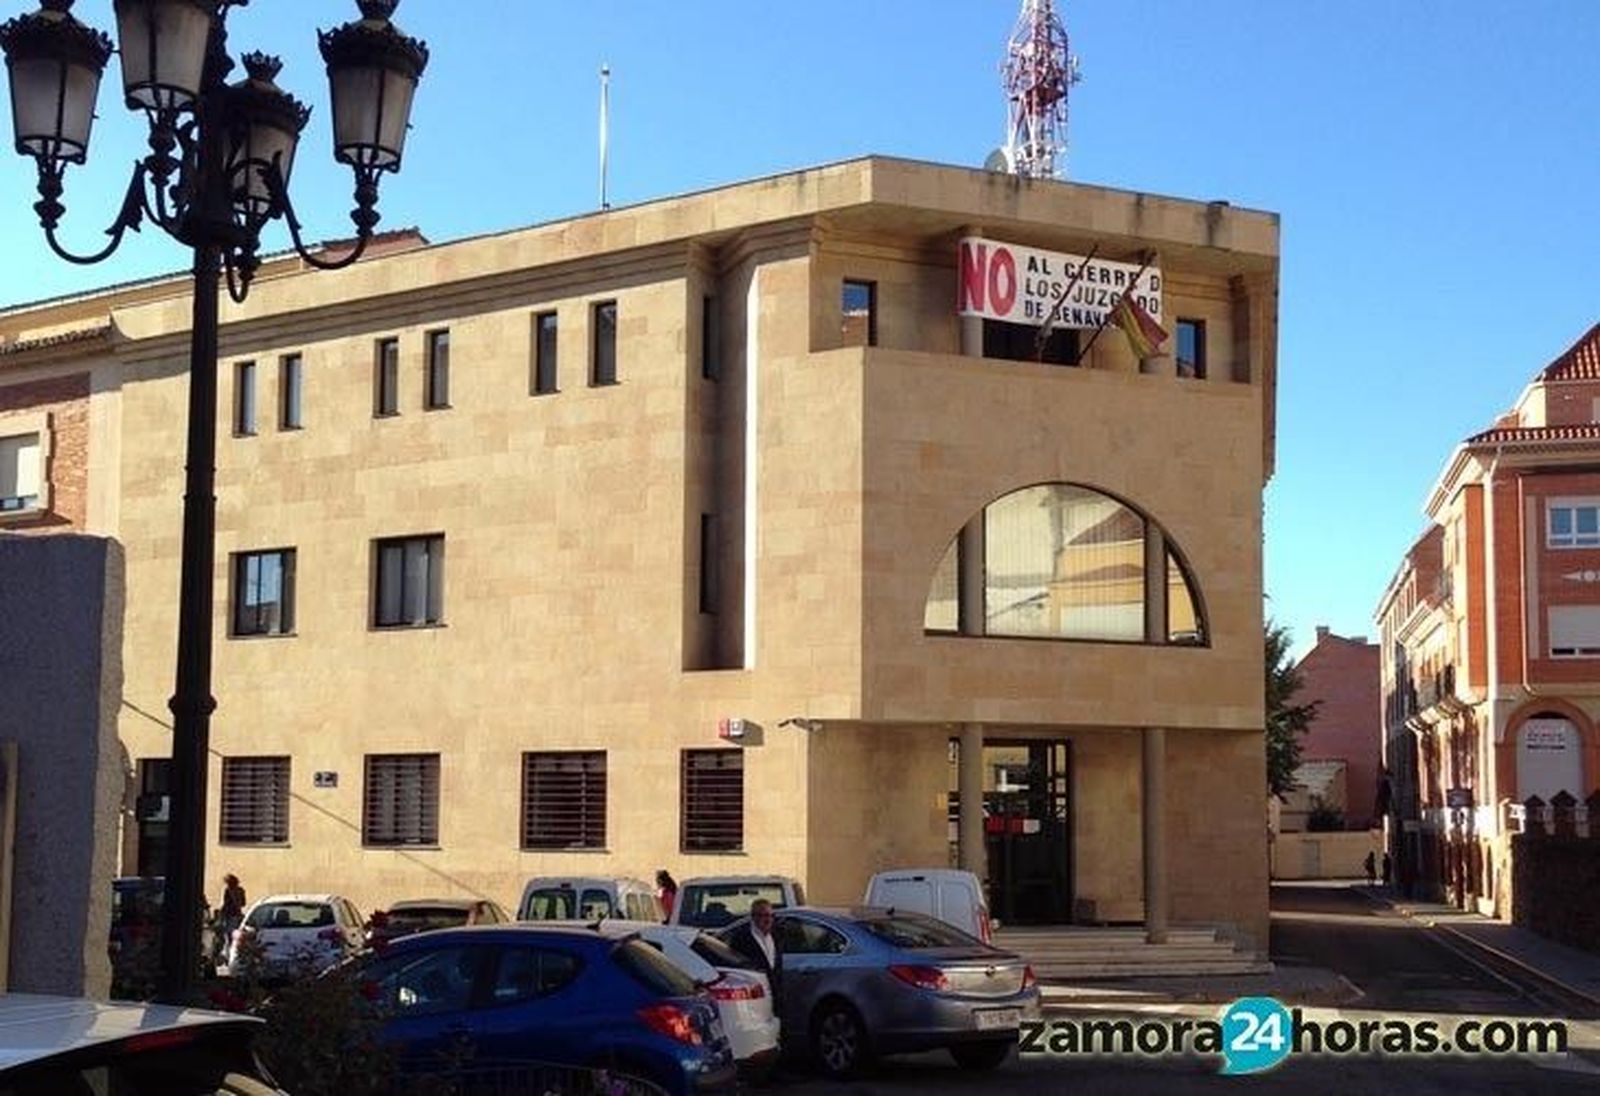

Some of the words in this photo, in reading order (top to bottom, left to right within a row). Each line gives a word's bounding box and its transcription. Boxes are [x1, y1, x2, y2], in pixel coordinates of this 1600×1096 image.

[959, 242, 1017, 317] NO
[1027, 255, 1052, 276] AL
[1024, 300, 1044, 319] DE
[1025, 277, 1063, 300] LOS
[1072, 285, 1159, 314] JUZGDO
